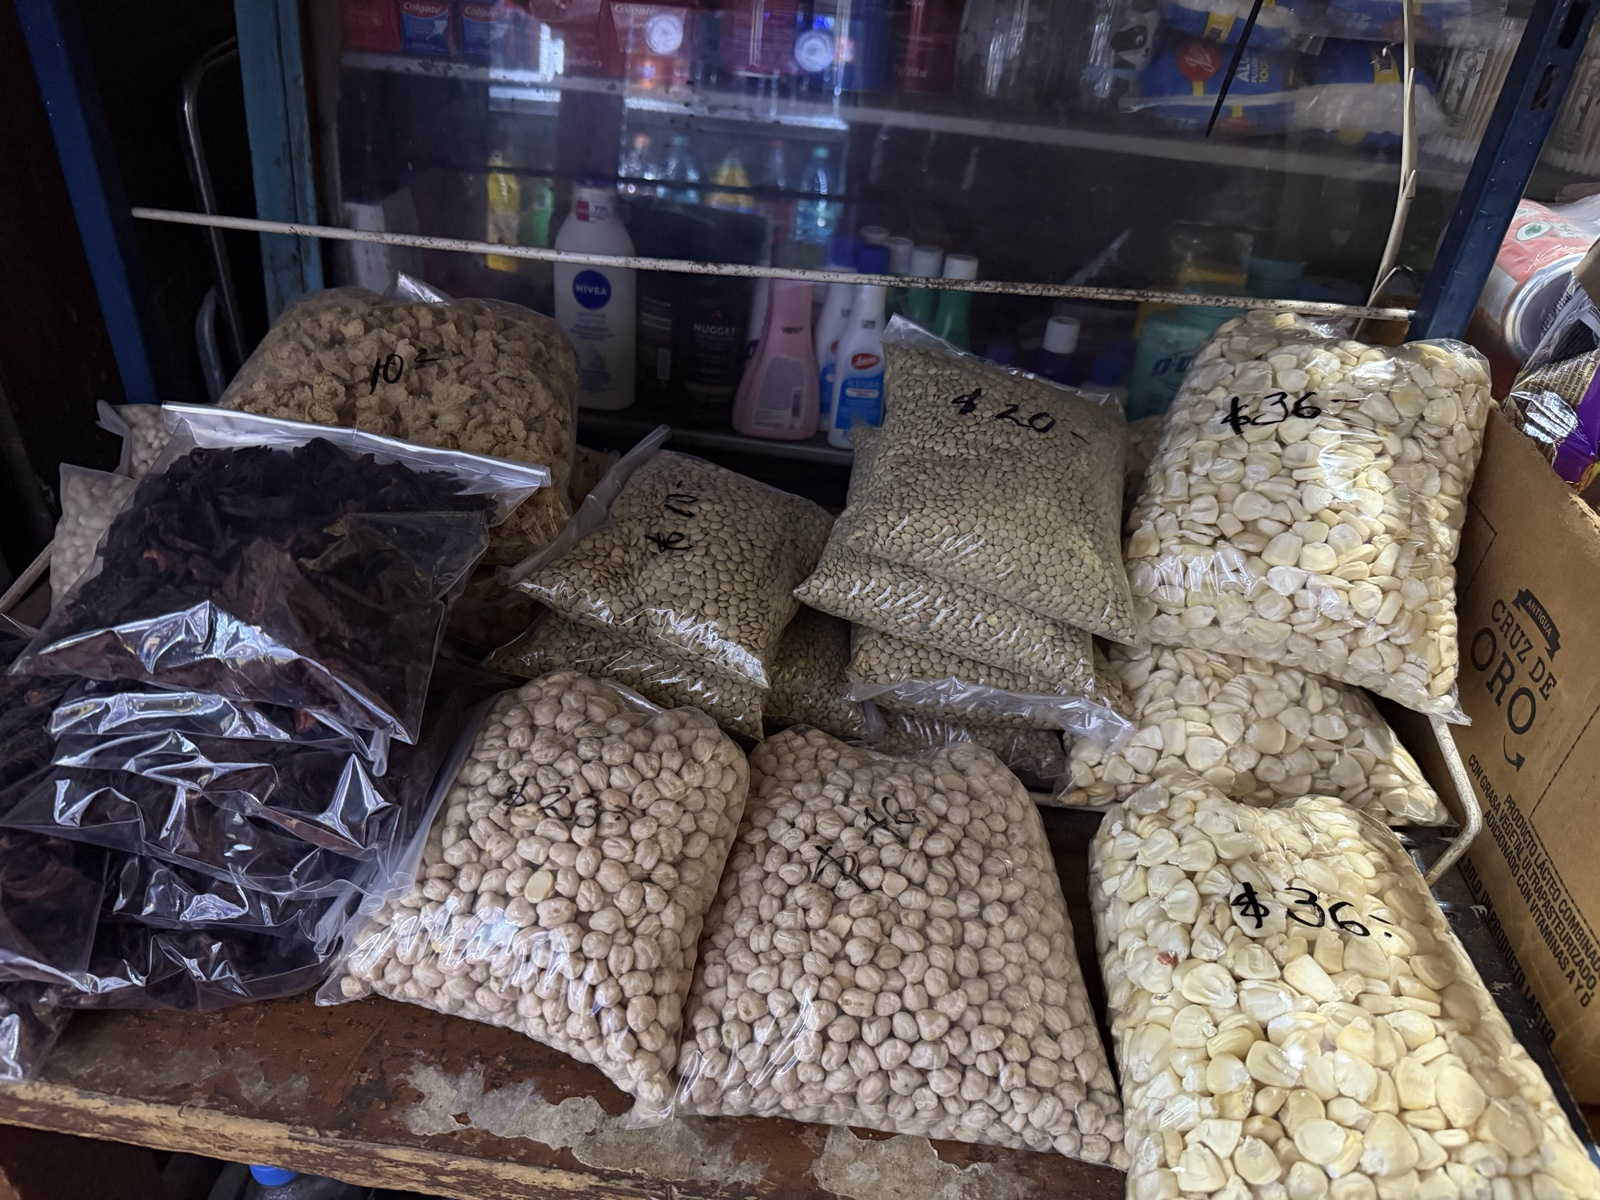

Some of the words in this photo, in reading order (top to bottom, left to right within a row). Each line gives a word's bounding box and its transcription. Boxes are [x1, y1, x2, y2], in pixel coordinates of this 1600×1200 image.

[403, 1, 441, 15] Colgate
[575, 284, 608, 297] NIVEA
[693, 323, 737, 338] NUGGET
[1490, 598, 1534, 665] CRUZ
[1528, 655, 1558, 702] DE
[1525, 598, 1553, 638] ANTIGUA
[1470, 626, 1537, 736] ORO
[1468, 753, 1484, 781] CON
[1479, 775, 1502, 816] GRASA
[1498, 808, 1525, 862] VEGETAL
[1521, 855, 1597, 998] ULTRAPASTEURIZADO,
[1503, 792, 1539, 858] PRODUCTO
[1533, 852, 1562, 903] LÁCTEO
[1483, 809, 1520, 878] ADICIONADO
[1516, 873, 1533, 905] CON
[1529, 898, 1570, 972] VITAMINAS
[1565, 968, 1576, 985] A
[1573, 978, 1584, 994] Y
[1579, 990, 1592, 1008] D
